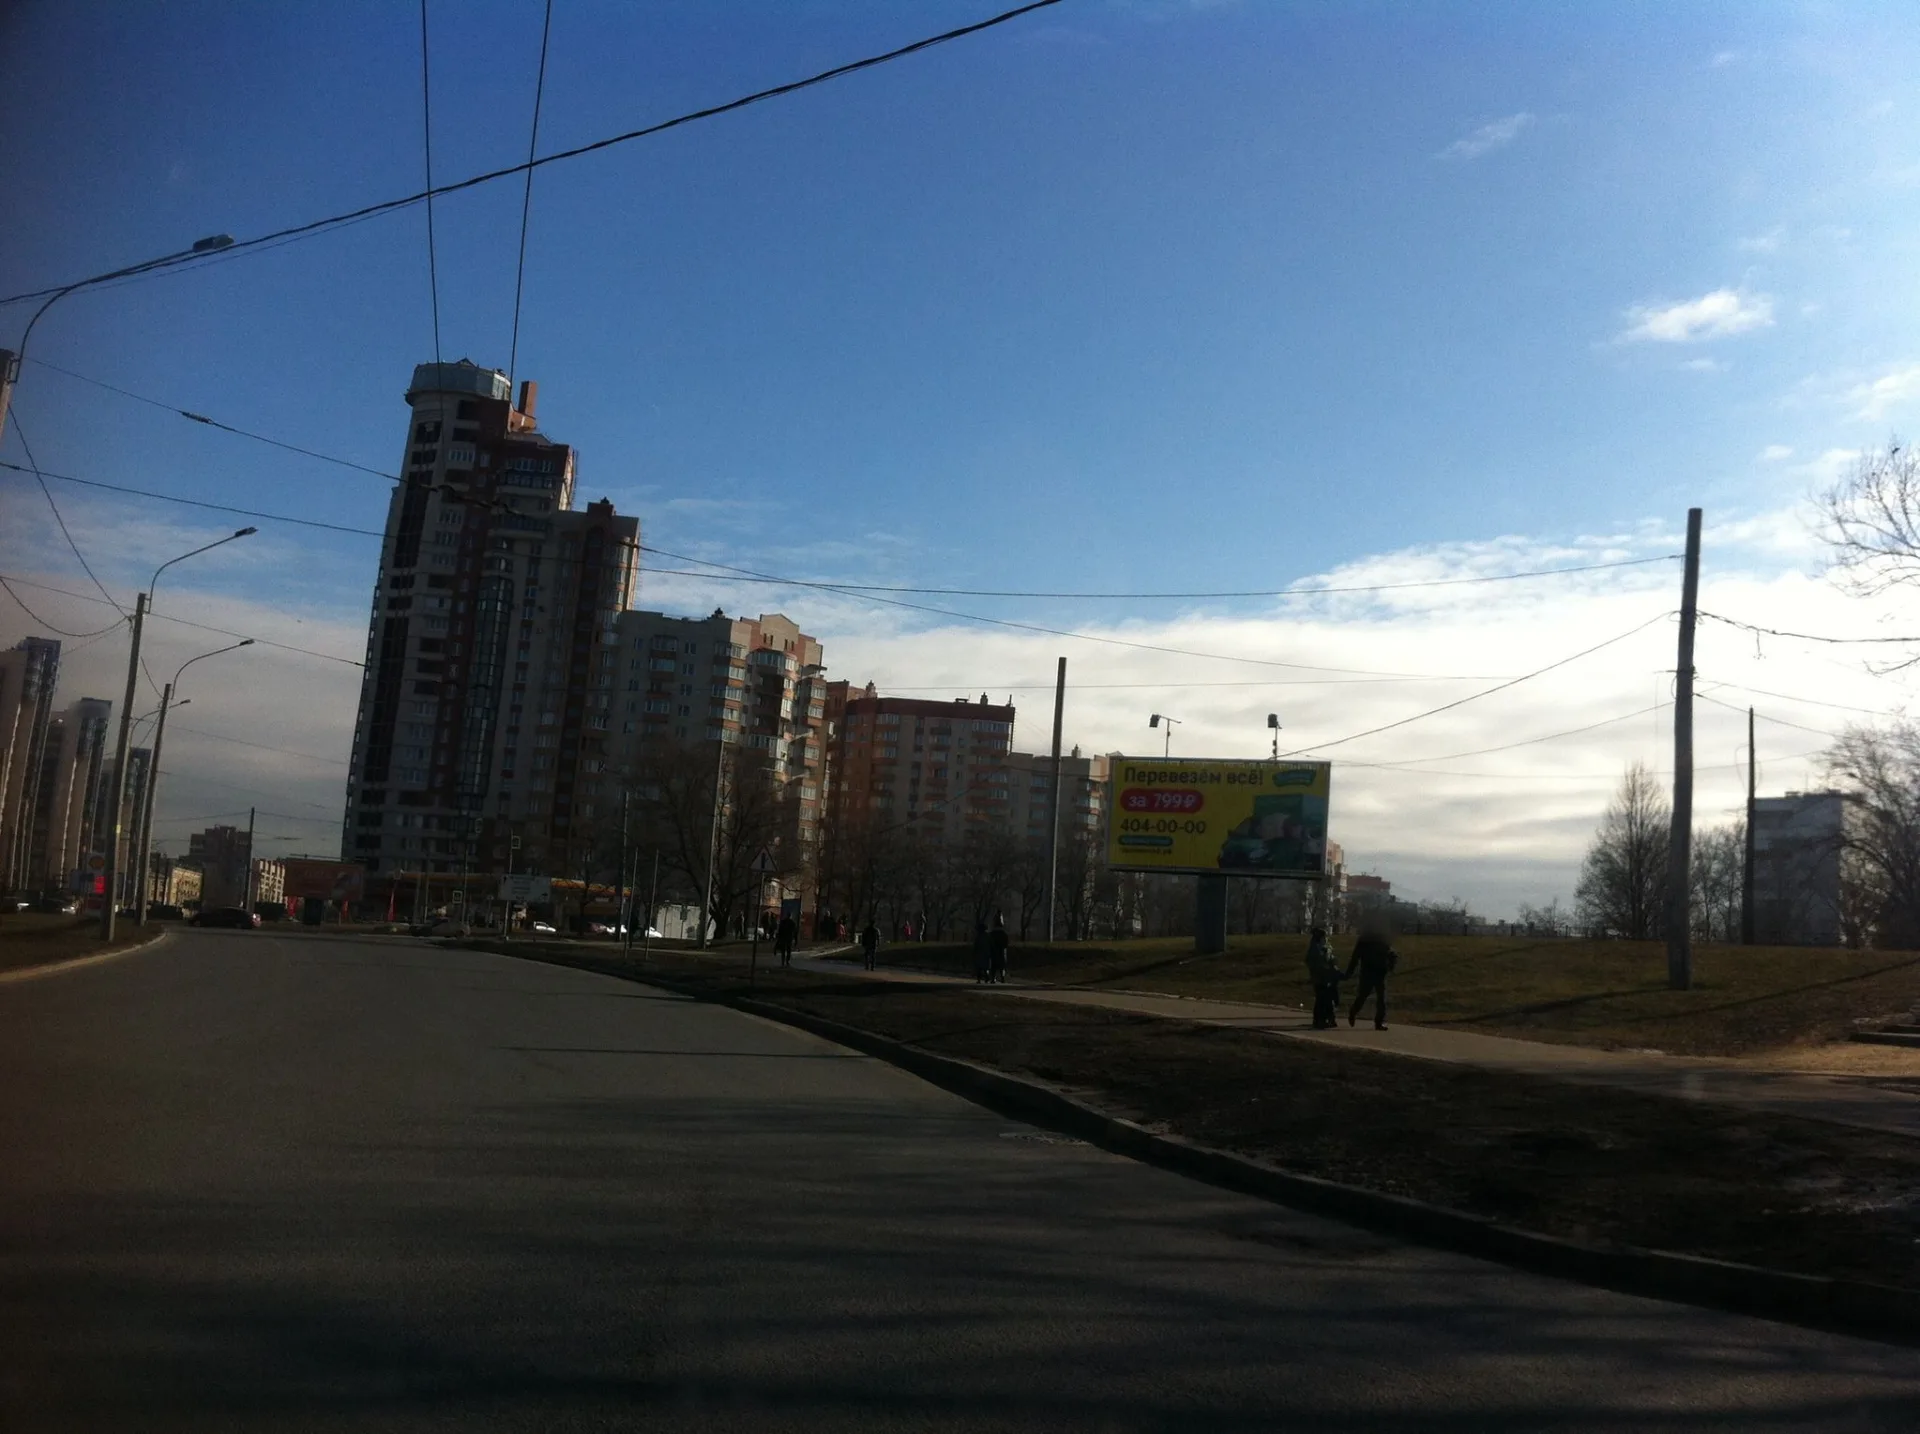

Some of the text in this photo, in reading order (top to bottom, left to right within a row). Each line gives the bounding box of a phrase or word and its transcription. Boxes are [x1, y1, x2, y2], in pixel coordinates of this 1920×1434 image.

[1124, 767, 1221, 785] Перевезём
[1227, 768, 1264, 785] всё!
[1128, 796, 1147, 808] за
[1120, 818, 1207, 834] 404-00-00
